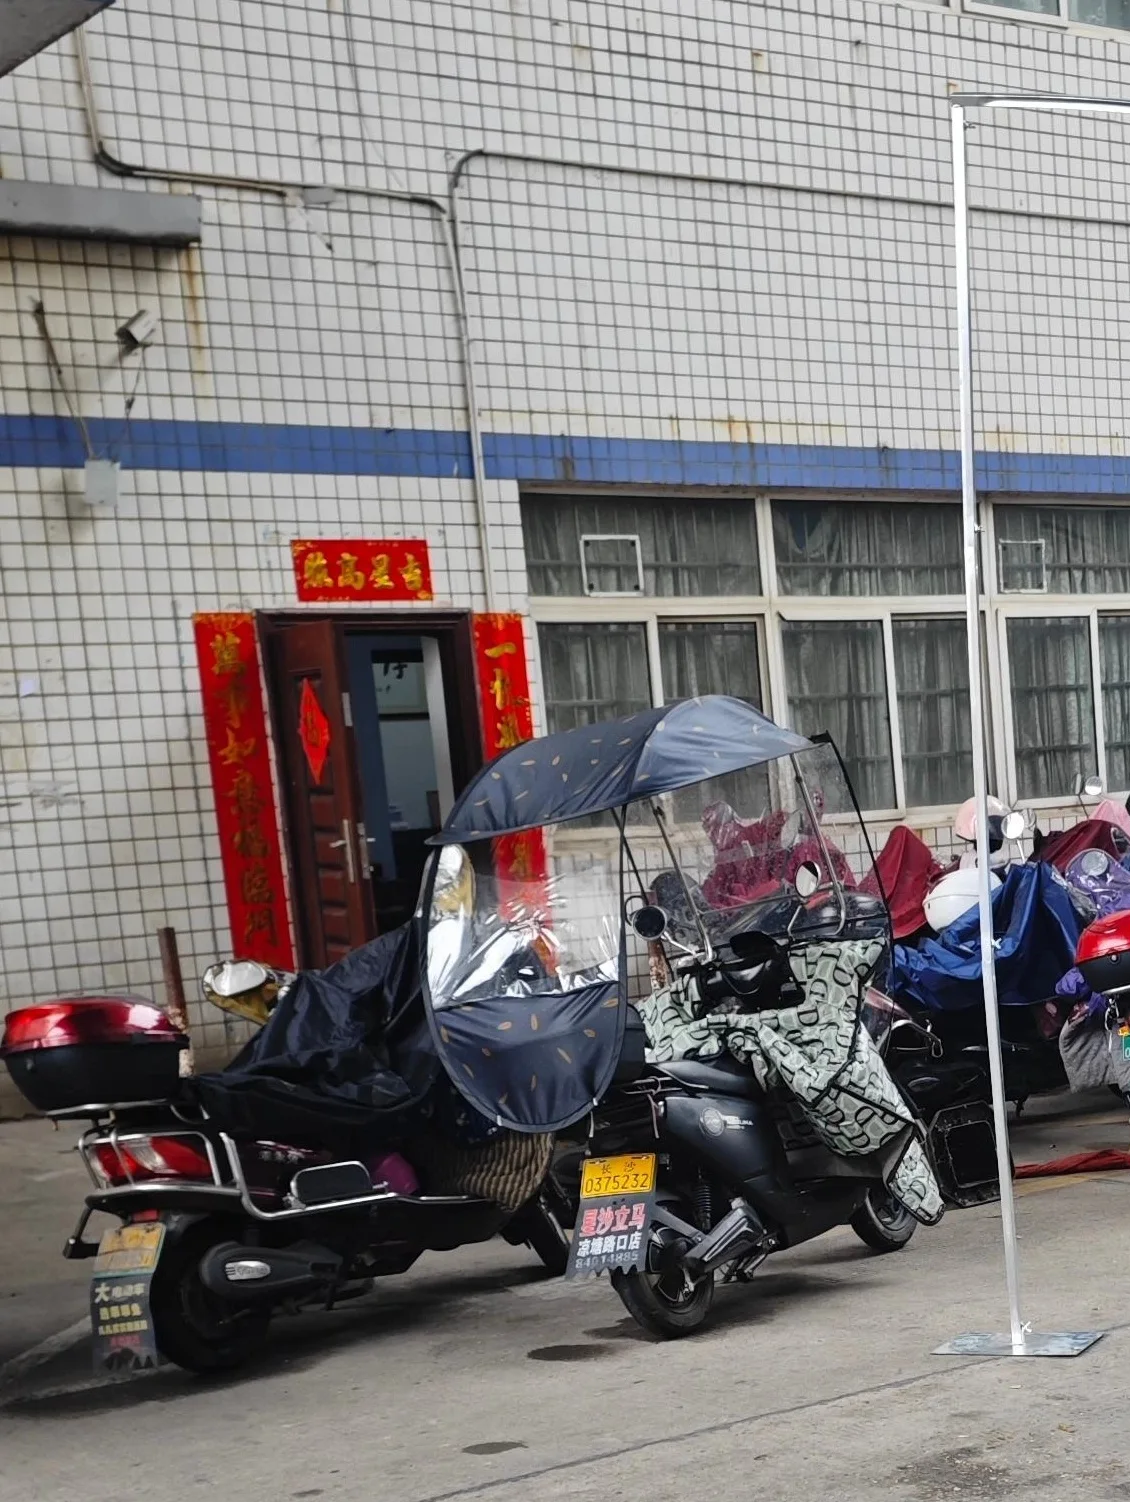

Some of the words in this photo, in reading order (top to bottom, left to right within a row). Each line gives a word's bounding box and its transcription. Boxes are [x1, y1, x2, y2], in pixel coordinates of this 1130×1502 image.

[601, 1160, 637, 1175] 长沙
[585, 1173, 650, 1194] 0375232
[578, 1202, 646, 1238] 星沙立马
